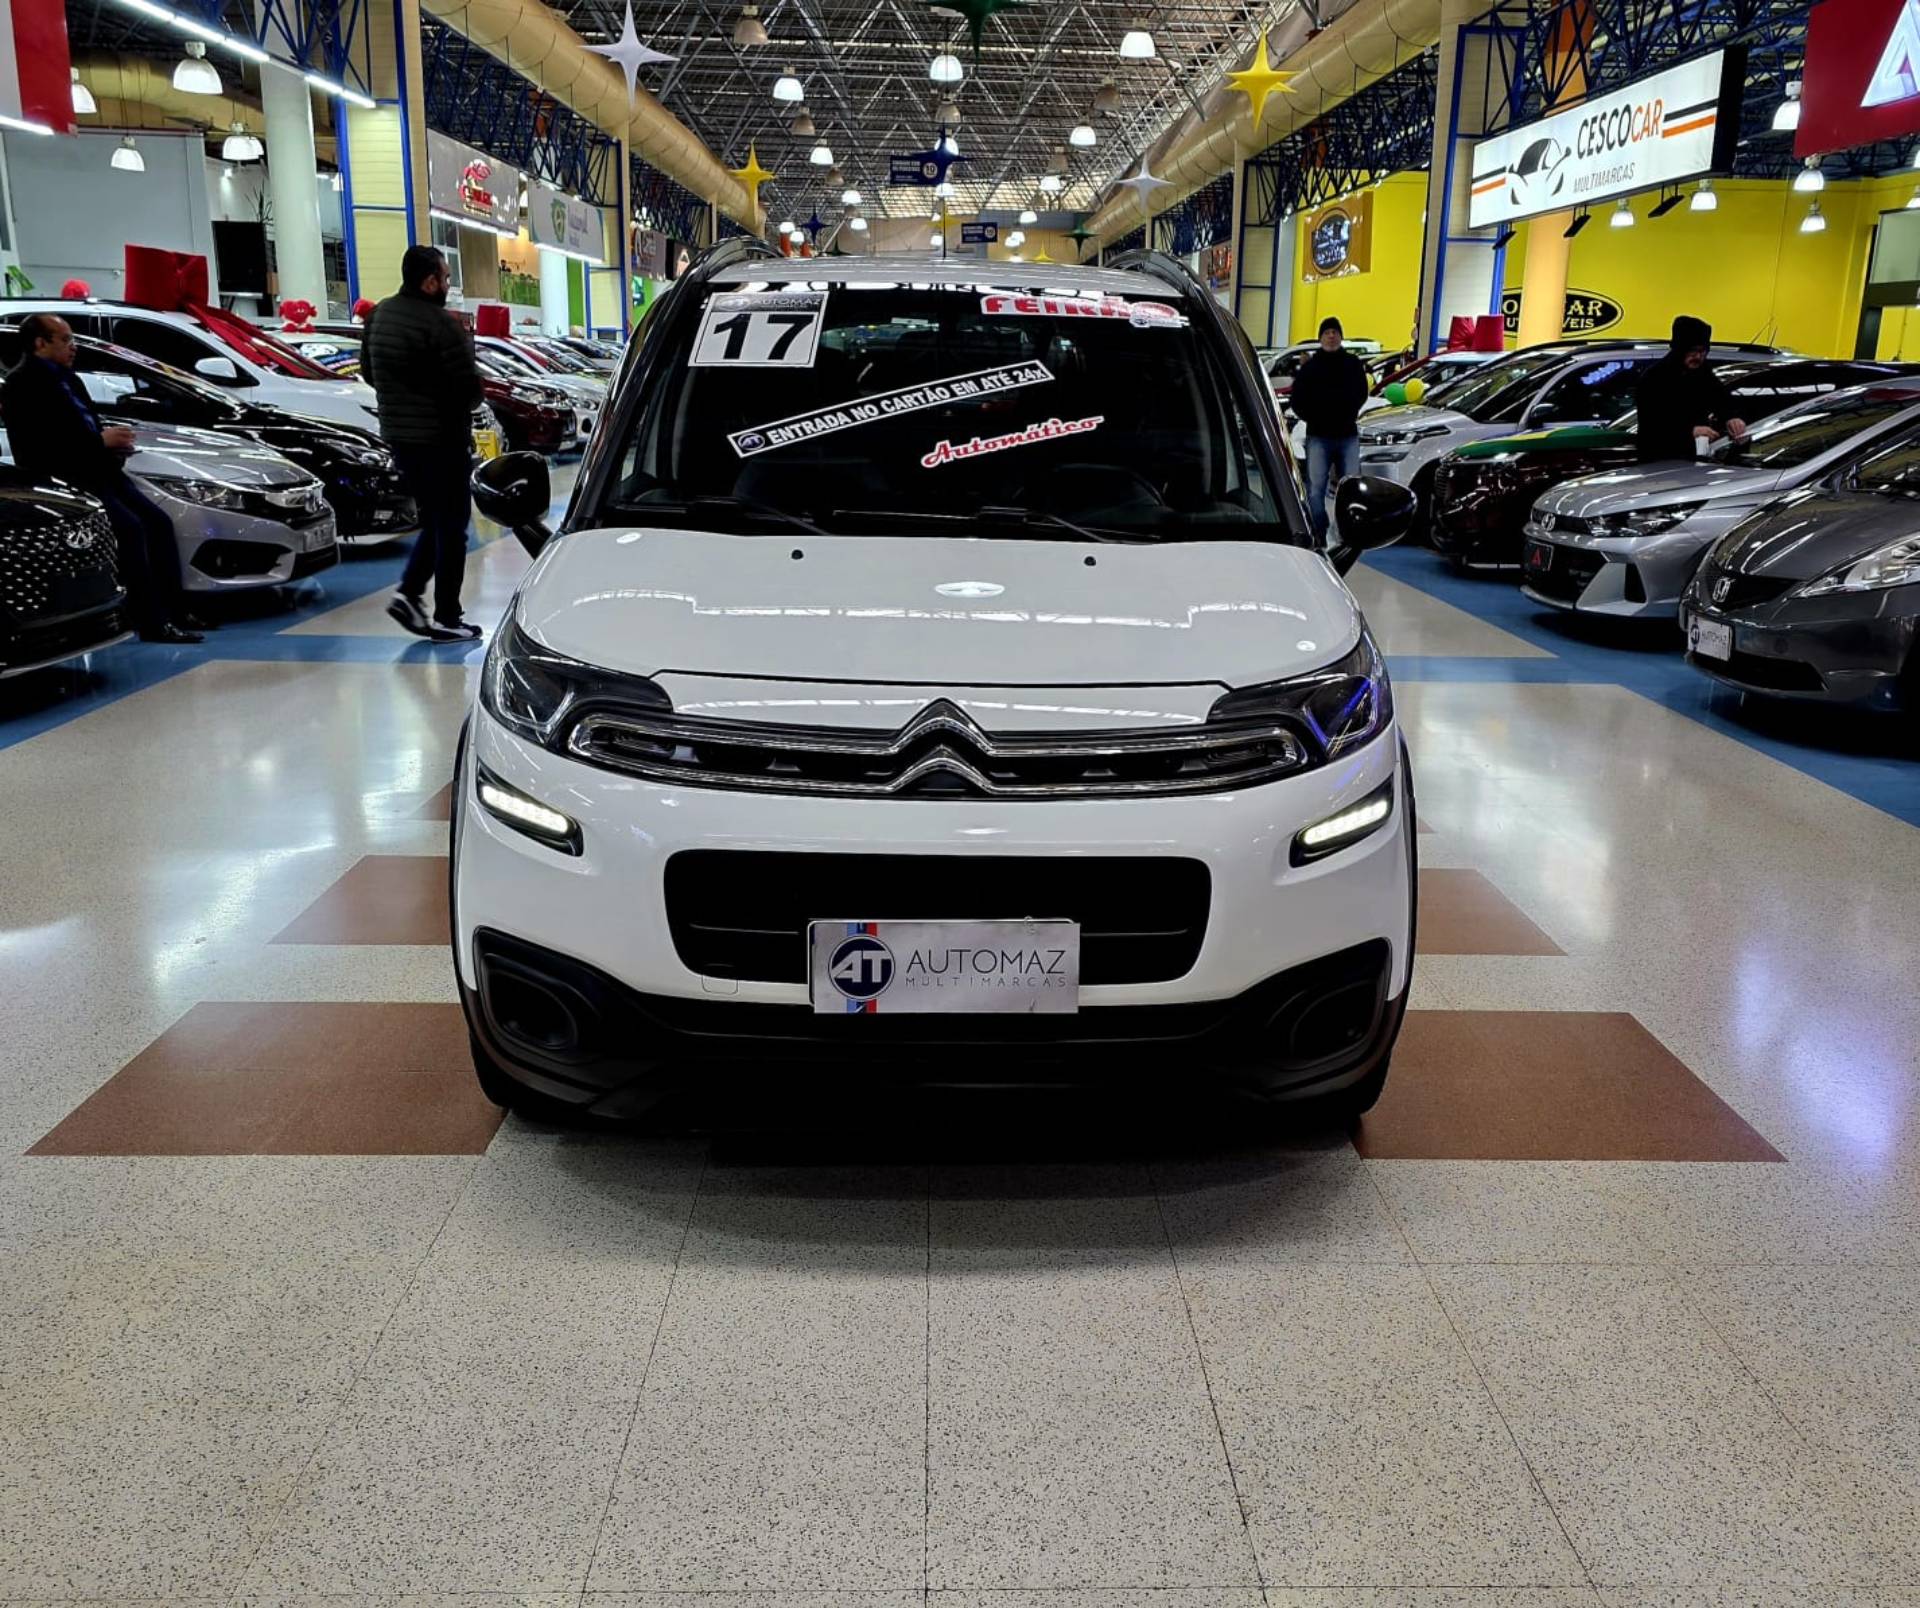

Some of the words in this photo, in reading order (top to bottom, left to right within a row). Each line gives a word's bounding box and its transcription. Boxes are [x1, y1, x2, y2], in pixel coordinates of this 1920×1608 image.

[1577, 98, 1663, 160] CESCOCAR
[1573, 161, 1636, 193] MULTIMARCAS
[713, 313, 815, 361] 17
[766, 411, 851, 444] ENTRADA
[848, 404, 879, 420] NO
[880, 387, 950, 413] CARTÃO
[950, 380, 979, 397] EM
[980, 371, 1014, 391] ATÉ
[1012, 368, 1046, 383] 24x
[922, 416, 1103, 467] Automático
[831, 949, 892, 983] AT
[905, 976, 1067, 988] MULTIMARCAS
[906, 949, 1067, 975] AUTOMAZ
